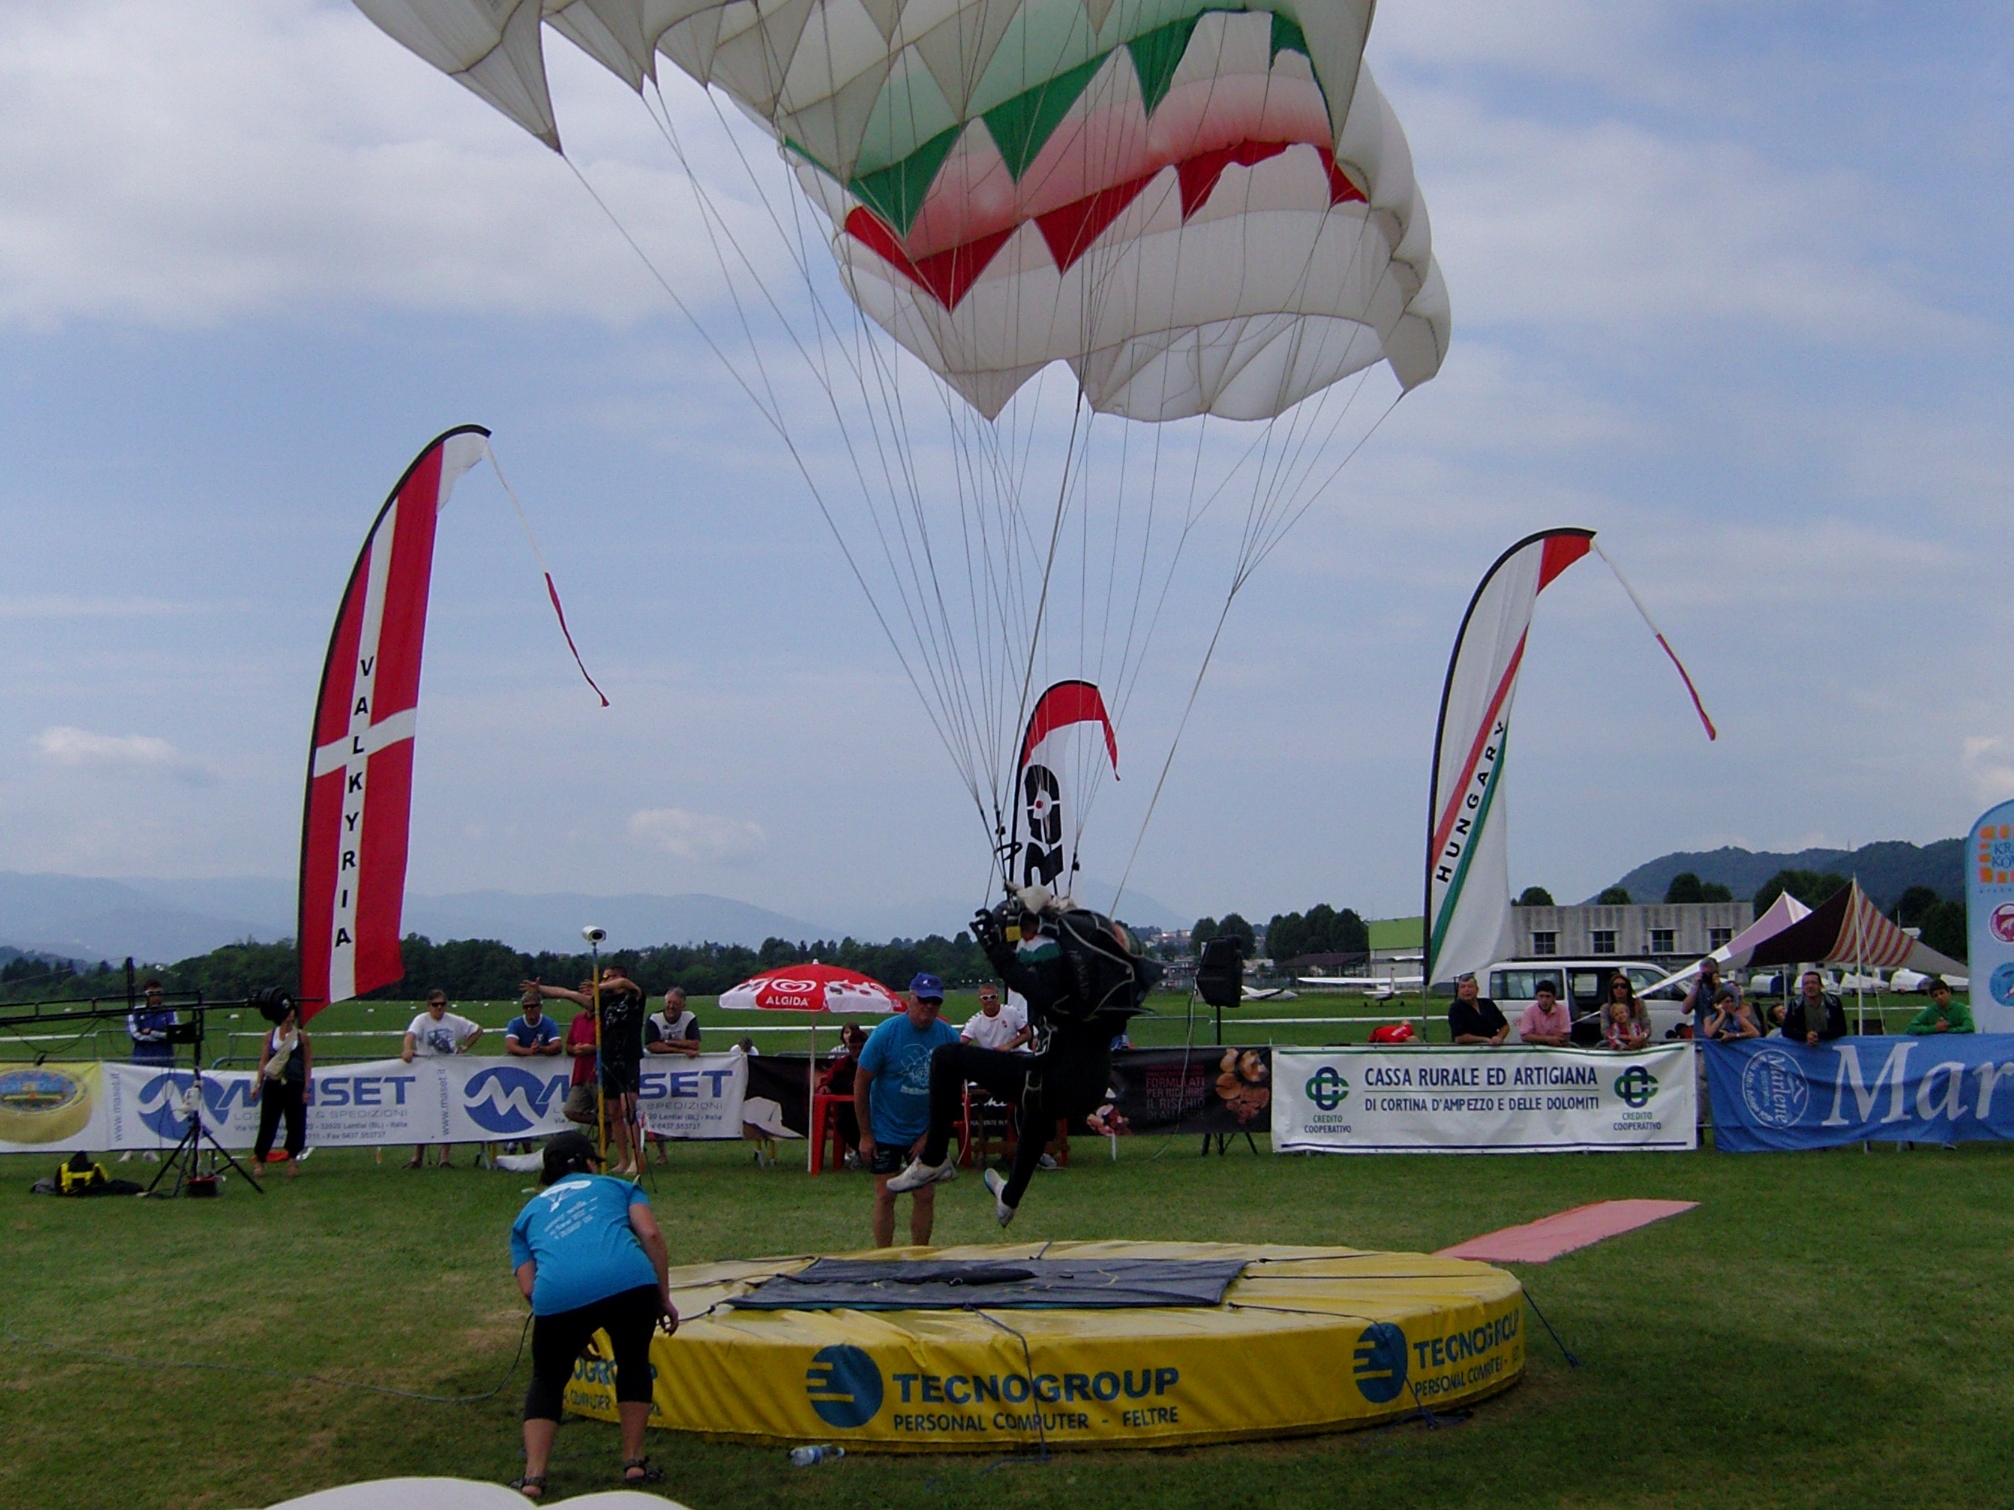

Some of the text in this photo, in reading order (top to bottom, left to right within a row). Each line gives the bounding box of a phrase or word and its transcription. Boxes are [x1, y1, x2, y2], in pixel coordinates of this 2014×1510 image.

[334, 656, 375, 947] VALKYRIA
[1435, 721, 1504, 883] HUNGARY
[1994, 842, 2014, 855] KR
[766, 996, 808, 1007] ALGIDA
[535, 1070, 733, 1101] MSET
[1364, 1066, 1598, 1087] CASSA RURALE ED ARTIGIANA
[1767, 1054, 1791, 1123] Marlene
[218, 1076, 416, 1108] MSET
[437, 1068, 450, 1136] www.maset.it
[1365, 1097, 1599, 1111] DI CORTINA D'AMPEZZO E DELLE DOLOMITI
[330, 1109, 408, 1120] SPEDIZIONI
[1313, 1115, 1343, 1124] CREDITO
[1613, 1122, 1662, 1131] COOPERATIVO
[1622, 1111, 1652, 1120] CREDITO
[1304, 1125, 1352, 1134] COOPERATIVO
[1413, 1308, 1520, 1370] TECNOGROUP
[892, 1367, 1180, 1405] TECNOGROUP
[1415, 1373, 1466, 1398] PERSONAL
[894, 1413, 987, 1432] PERSONAL
[993, 1412, 1089, 1431] COMPUTER
[1123, 1406, 1179, 1428] FELTRE
